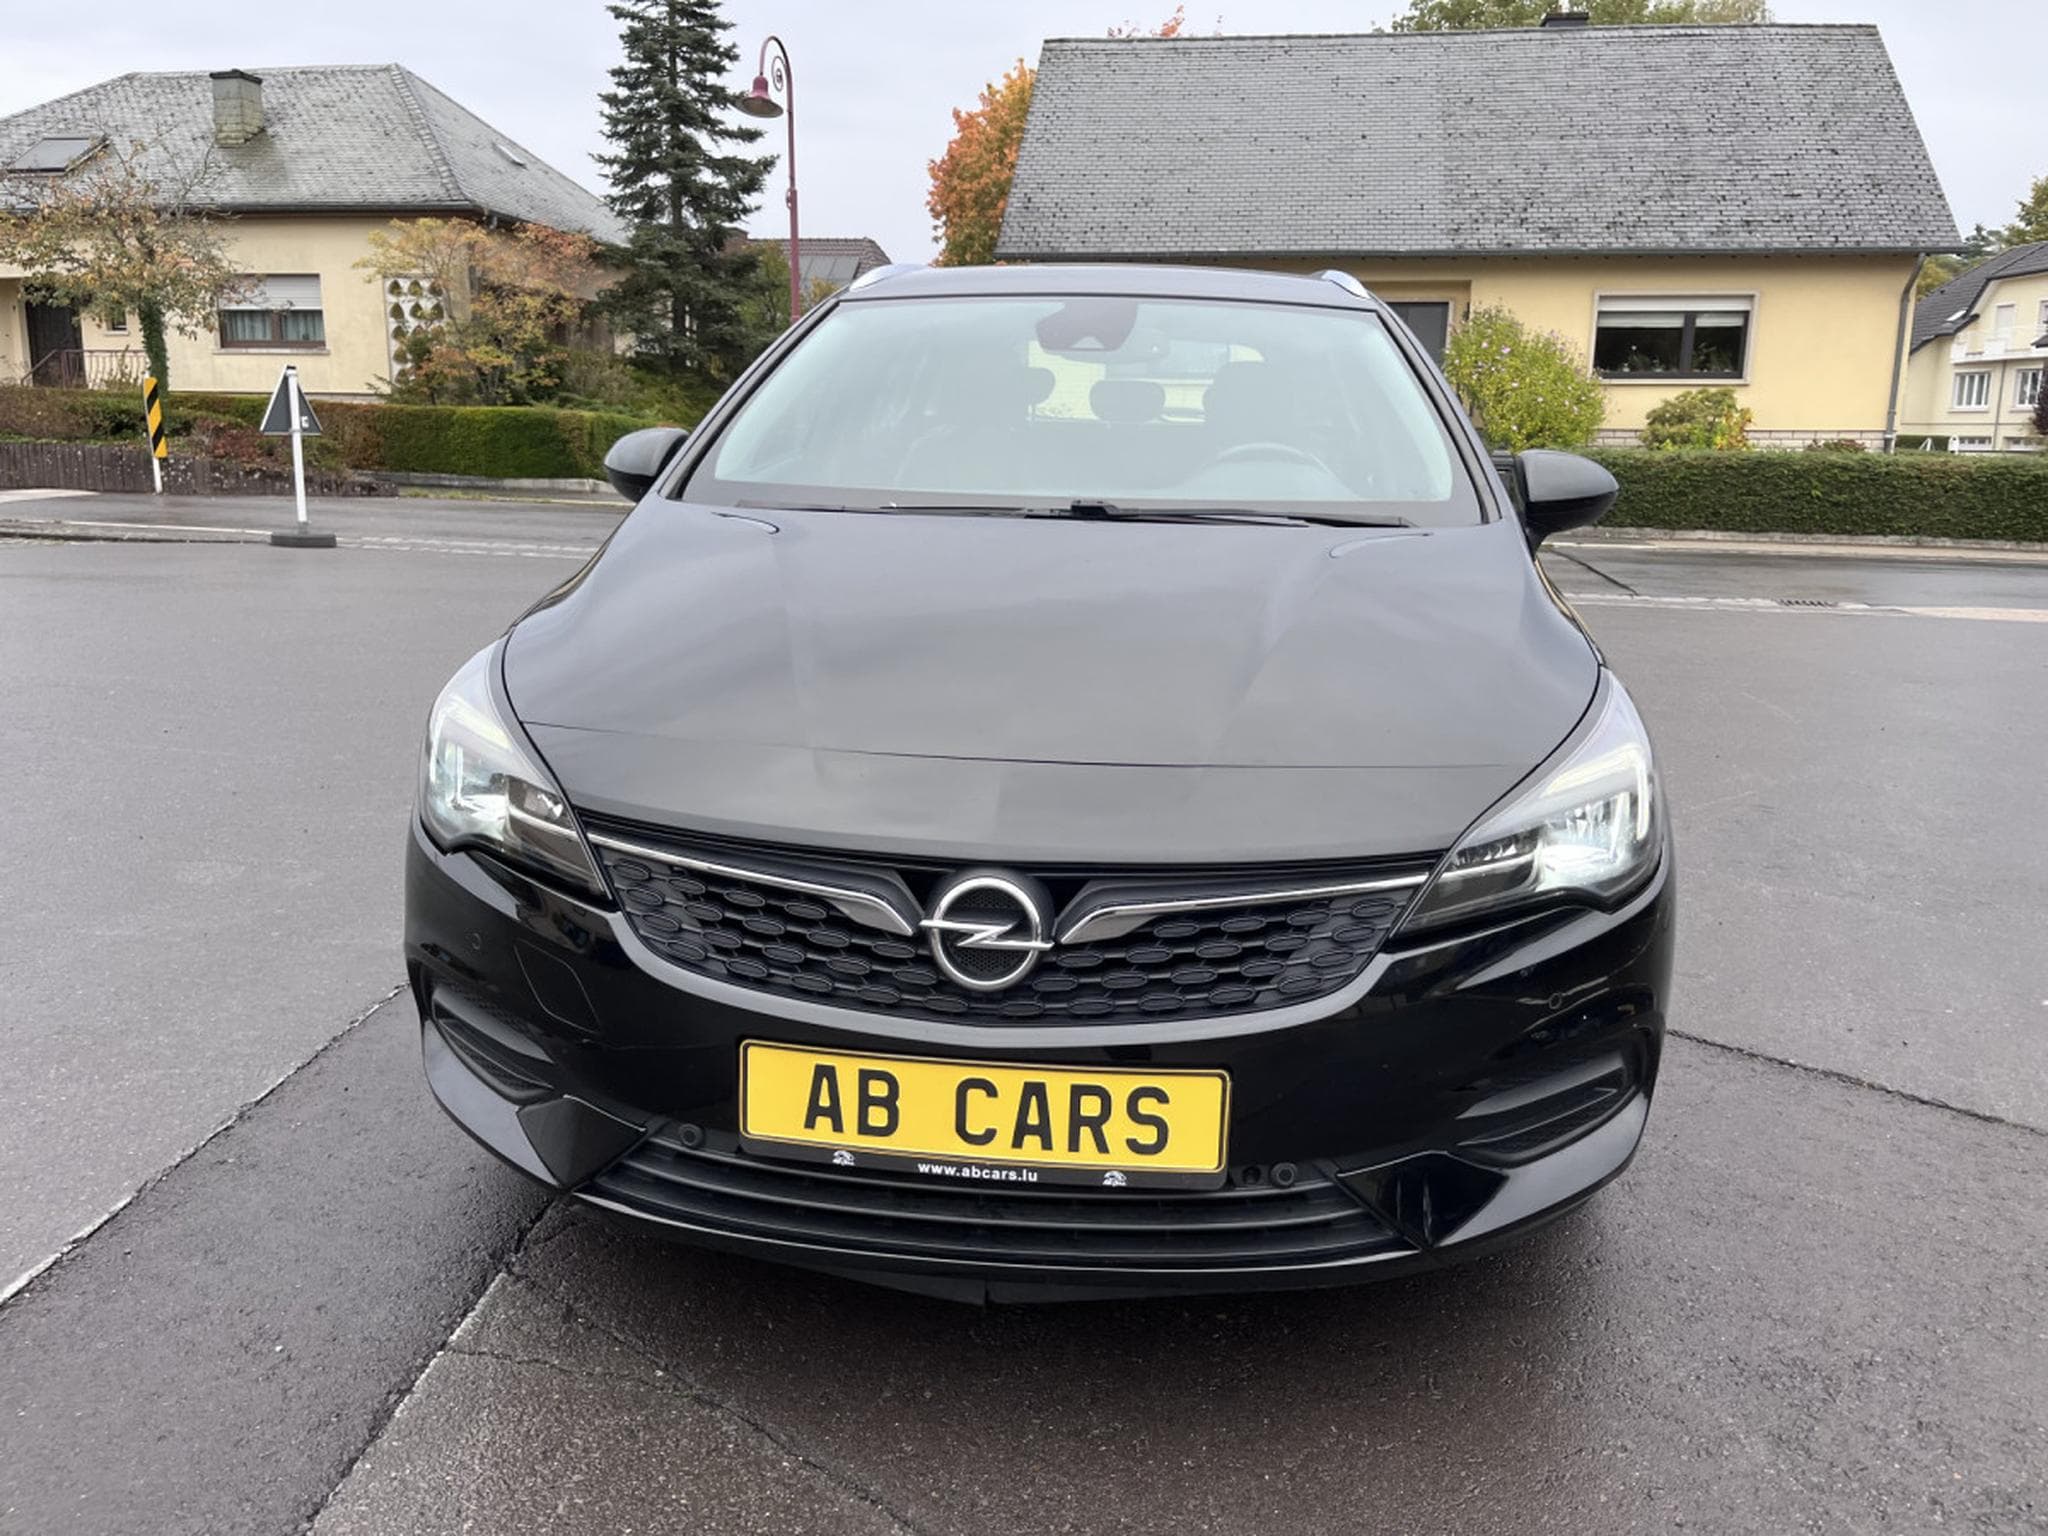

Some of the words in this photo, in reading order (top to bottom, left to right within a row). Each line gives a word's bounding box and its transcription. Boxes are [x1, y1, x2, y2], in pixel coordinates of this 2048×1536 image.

[803, 1063, 900, 1138] AB
[955, 1077, 1170, 1156] CARS
[917, 1163, 1038, 1182] www.abcars.lu
